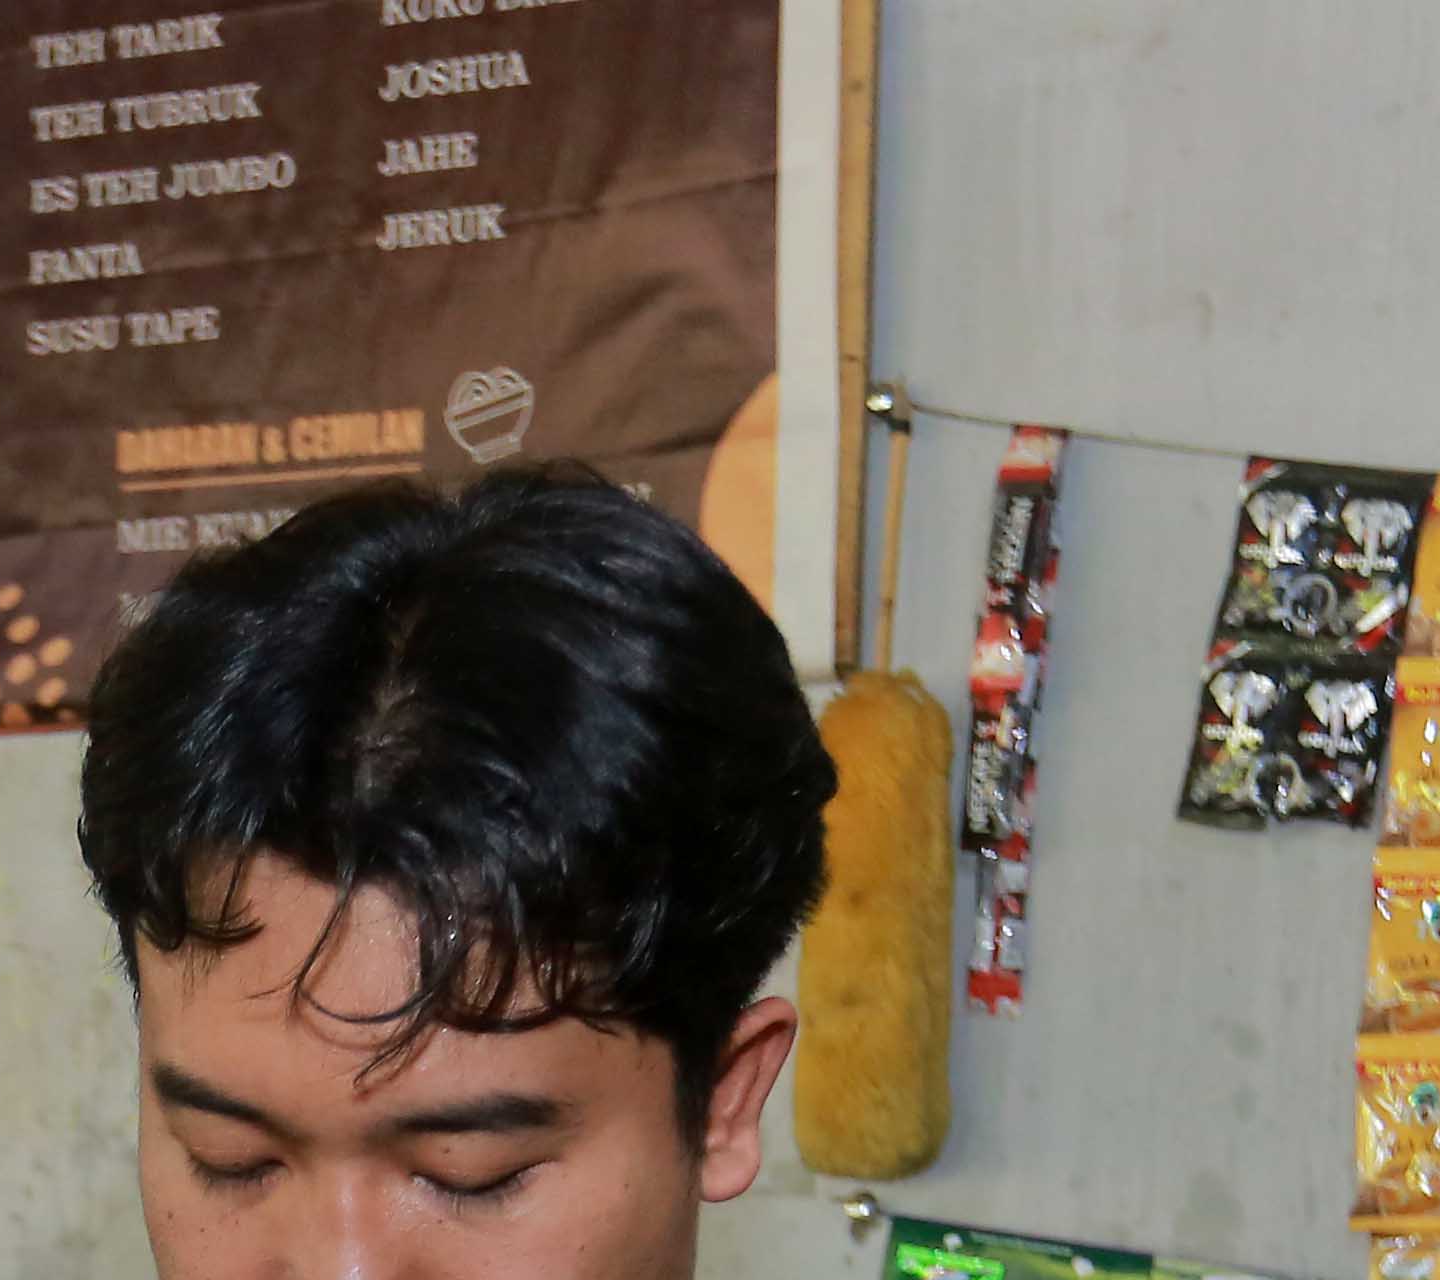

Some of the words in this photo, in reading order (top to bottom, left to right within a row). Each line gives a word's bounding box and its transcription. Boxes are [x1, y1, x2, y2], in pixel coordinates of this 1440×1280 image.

[29, 28, 106, 69] TEH
[112, 12, 224, 59] TARIK
[378, 51, 531, 102] JOSHUA
[29, 101, 106, 143] TEH
[111, 82, 263, 132] TUBRUK
[377, 131, 479, 177] JAHE
[29, 176, 79, 214] ES
[82, 168, 160, 208] TEH
[164, 152, 296, 201] JUMBO
[376, 203, 508, 251] JERUK
[27, 240, 145, 285] FANTA
[26, 315, 120, 356] SUSU
[124, 305, 221, 347] TAPE
